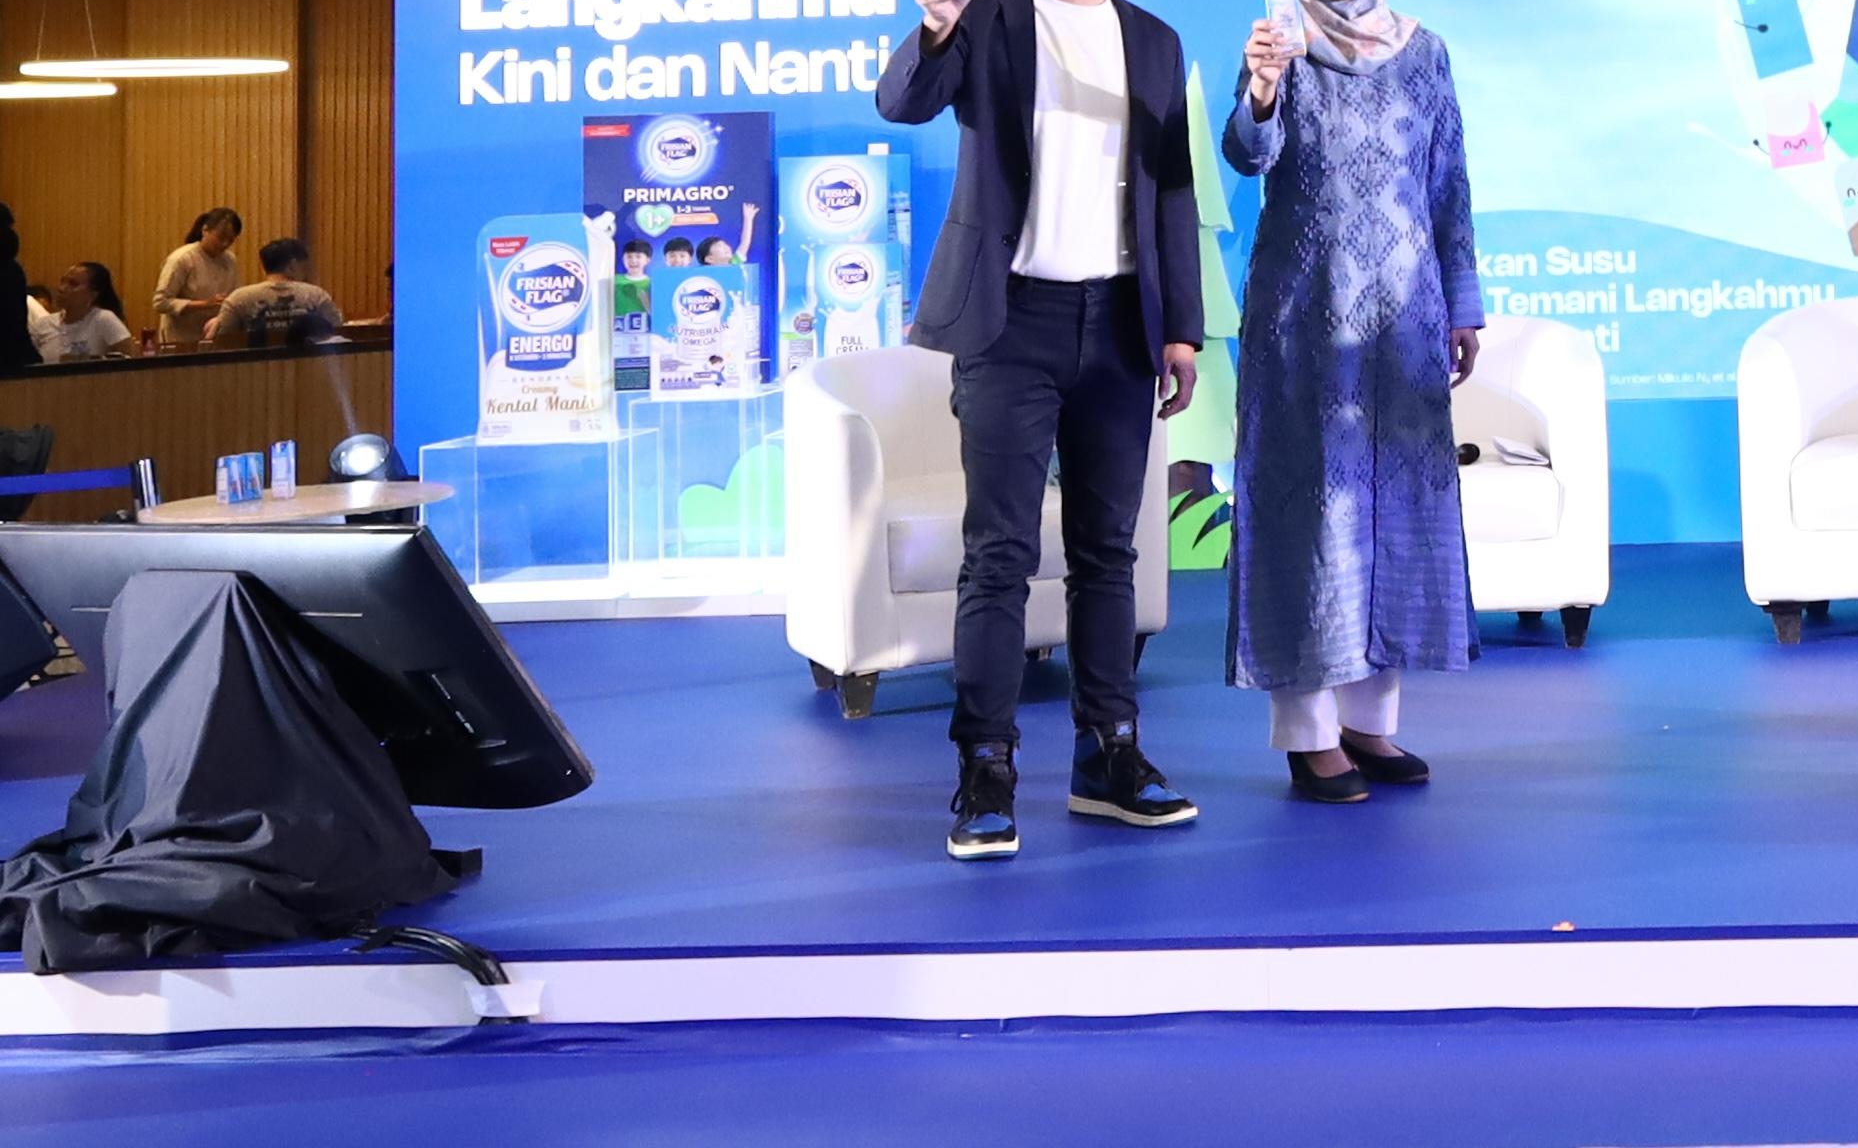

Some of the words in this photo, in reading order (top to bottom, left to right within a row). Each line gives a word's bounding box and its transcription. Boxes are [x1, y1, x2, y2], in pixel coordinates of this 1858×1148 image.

[459, 46, 571, 105] Kini
[584, 45, 706, 100] dan
[719, 35, 890, 96] Nanti
[645, 212, 666, 228] 1+
[1475, 249, 1538, 277] kan
[1545, 245, 1637, 276] Susu
[516, 275, 576, 291] FRISIAN
[1485, 282, 1617, 315] Temani
[1624, 279, 1835, 318] Langkahmu
[509, 334, 574, 354] ENERGO
[681, 336, 717, 346] OMEGA
[841, 336, 863, 346] FULL
[487, 398, 538, 415] Kental
